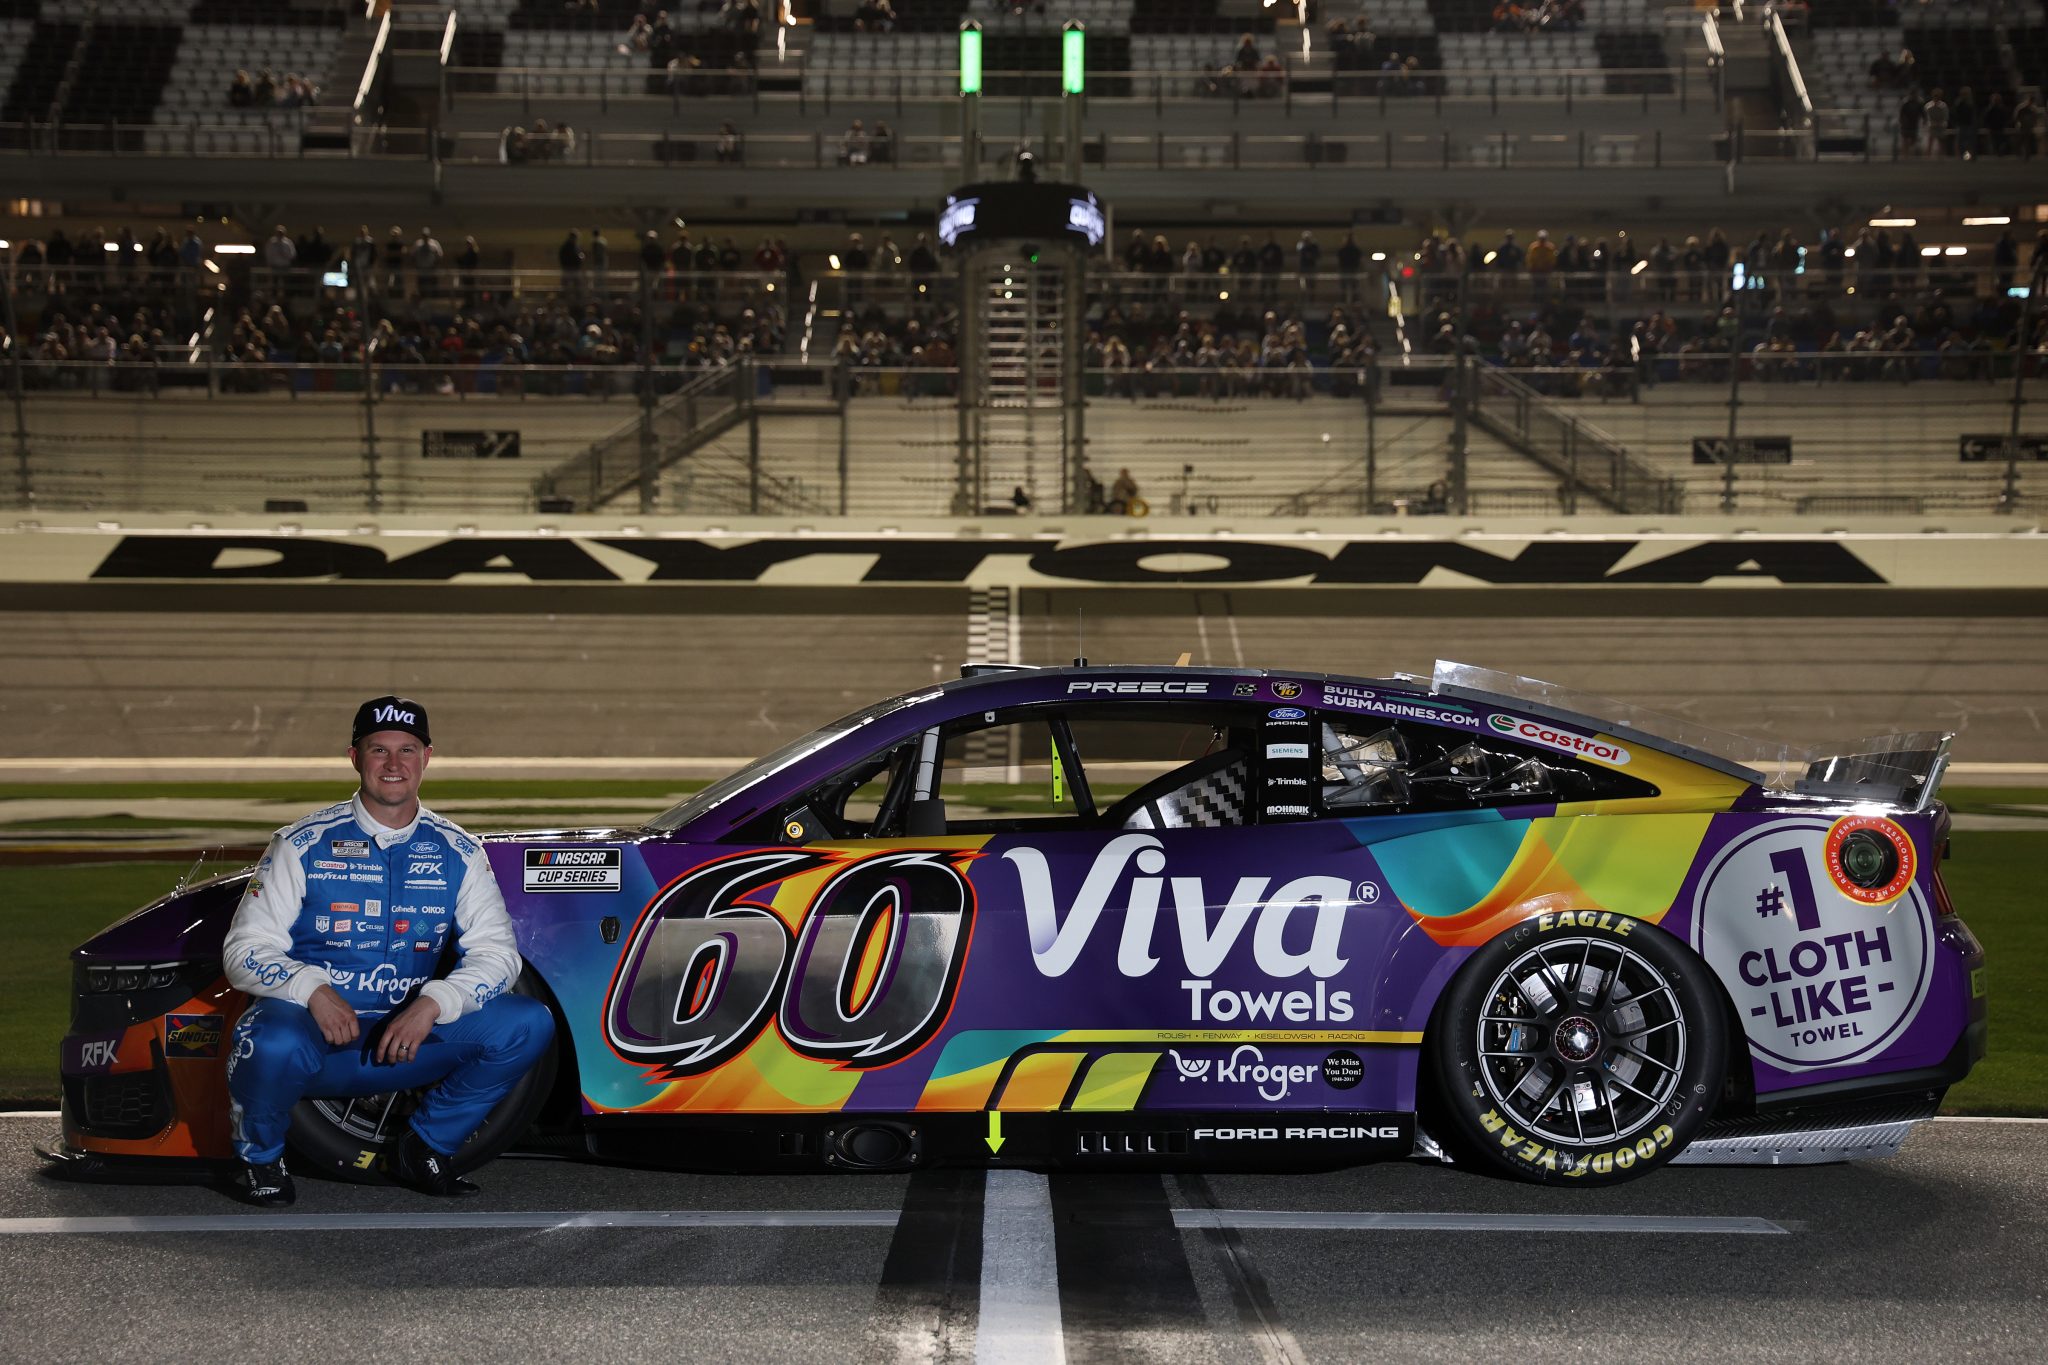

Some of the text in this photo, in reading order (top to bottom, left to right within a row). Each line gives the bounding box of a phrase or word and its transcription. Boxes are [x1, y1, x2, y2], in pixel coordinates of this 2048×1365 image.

[90, 536, 1891, 584] DAYTONA
[1067, 681, 1210, 694] PREECE
[1324, 685, 1376, 699] BUILD
[373, 704, 416, 725] Viva
[1275, 709, 1299, 718] Ford
[1322, 694, 1480, 727] SUBMARINES.COM
[1519, 723, 1620, 761] Castrol
[1275, 777, 1308, 786] Trimble
[1266, 805, 1310, 814] MOHAWK
[1836, 818, 1868, 840] FENWAY
[293, 830, 315, 847] OMP
[455, 838, 475, 854] OMP
[415, 844, 434, 852] Ford
[321, 861, 346, 869] Castrol
[555, 852, 607, 865] NASCAR
[357, 863, 383, 872] Trimble
[350, 873, 384, 882] MOHAWK
[537, 870, 608, 882] CUP SERIES
[1756, 847, 1821, 932] #1
[1001, 833, 1352, 978] Viva
[1538, 910, 1639, 938] EAGLE
[1738, 926, 1892, 987] CLOTH
[601, 847, 988, 1085] 60
[357, 963, 428, 1005] Kroger
[1181, 980, 1355, 1023] Towels
[168, 1030, 221, 1044] SUNOCO
[1157, 1032, 1191, 1040] ROUSH
[1202, 1032, 1242, 1040] FENWAY
[1254, 1032, 1316, 1040] KESELOWSKI
[1790, 1021, 1864, 1047] TOWEL
[81, 1039, 119, 1068] RFK
[1326, 1058, 1360, 1066] We Miss
[1217, 1044, 1319, 1101] Kroger
[1325, 1067, 1362, 1076] You Don!
[1194, 1127, 1399, 1140] FORD RACING
[1478, 1108, 1674, 1177] GOODYEAR
